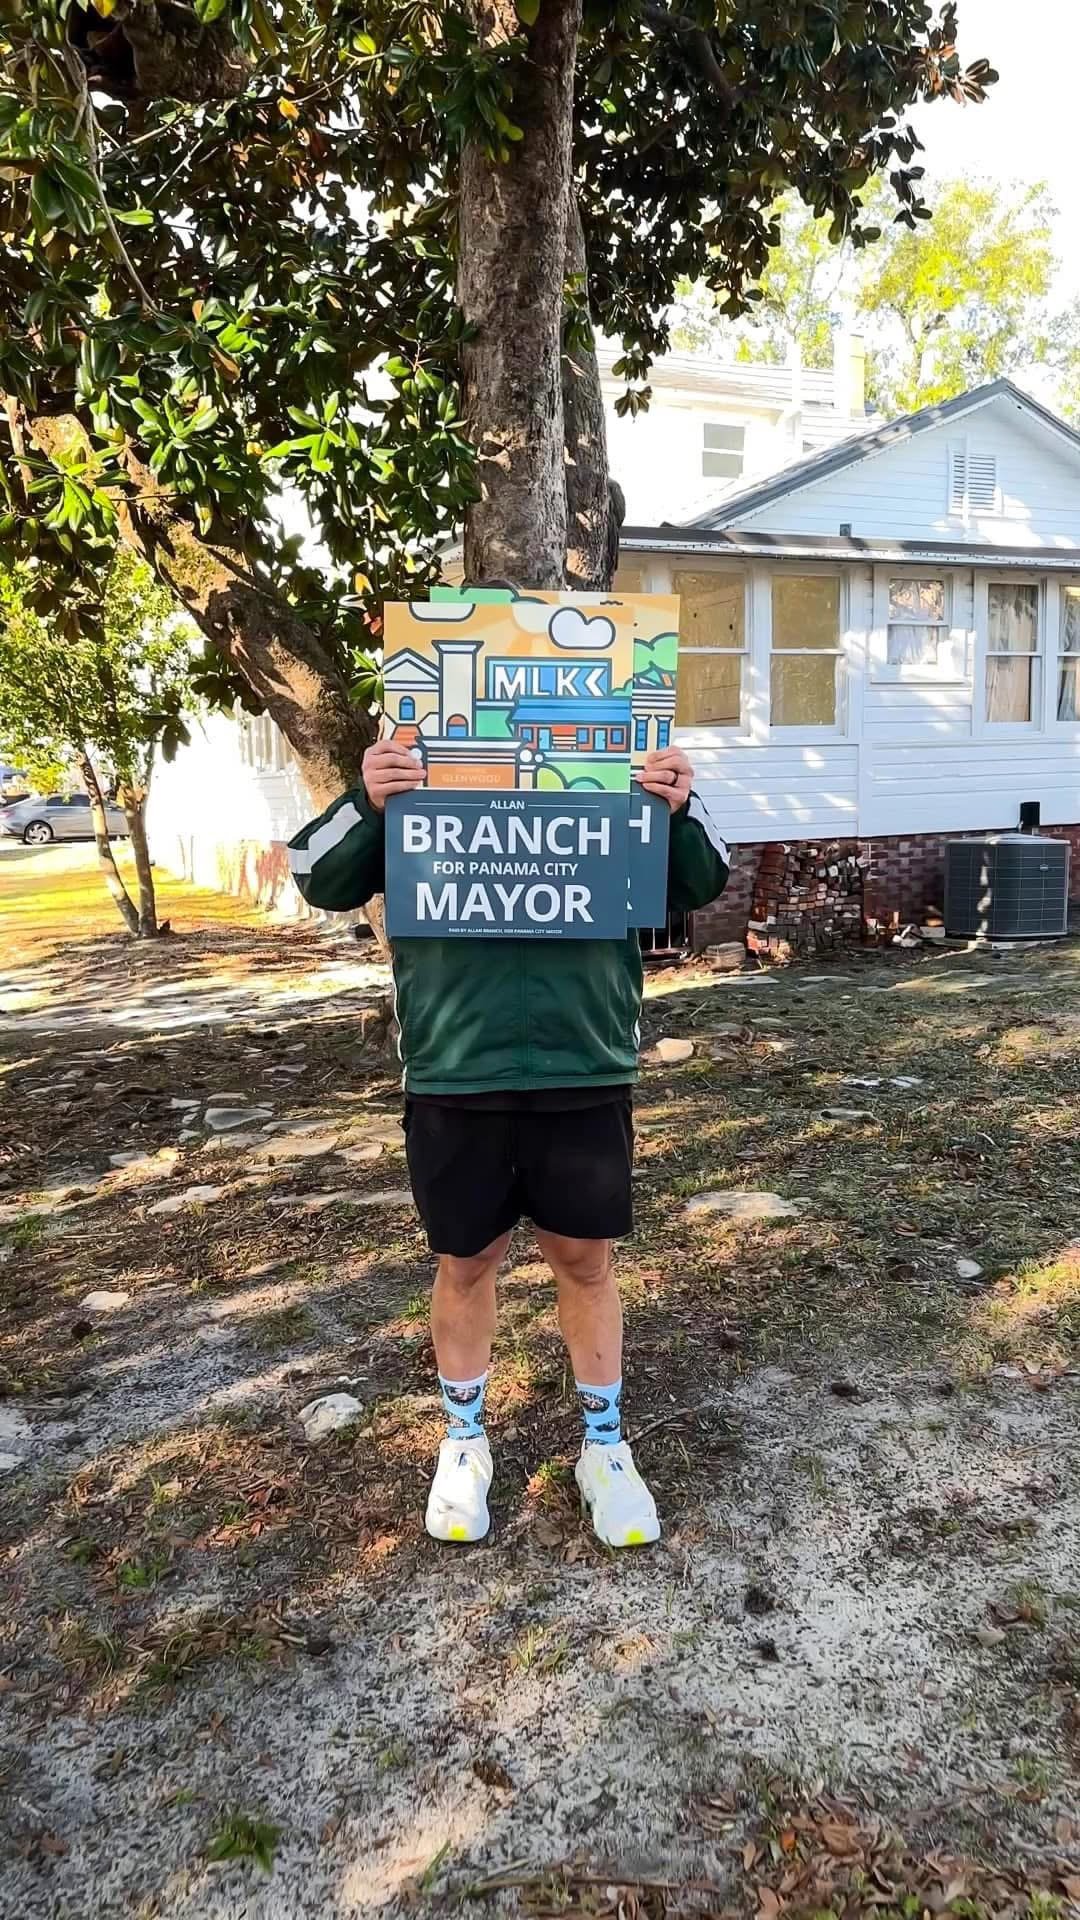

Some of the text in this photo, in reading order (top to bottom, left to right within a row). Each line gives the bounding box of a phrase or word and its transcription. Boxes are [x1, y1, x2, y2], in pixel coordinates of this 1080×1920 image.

[495, 666, 580, 700] MLK
[489, 800, 525, 810] ALLAN
[402, 814, 610, 856] BRANCH
[433, 862, 578, 876] FOR PANAMA CITY
[416, 882, 594, 923] MAYOR
